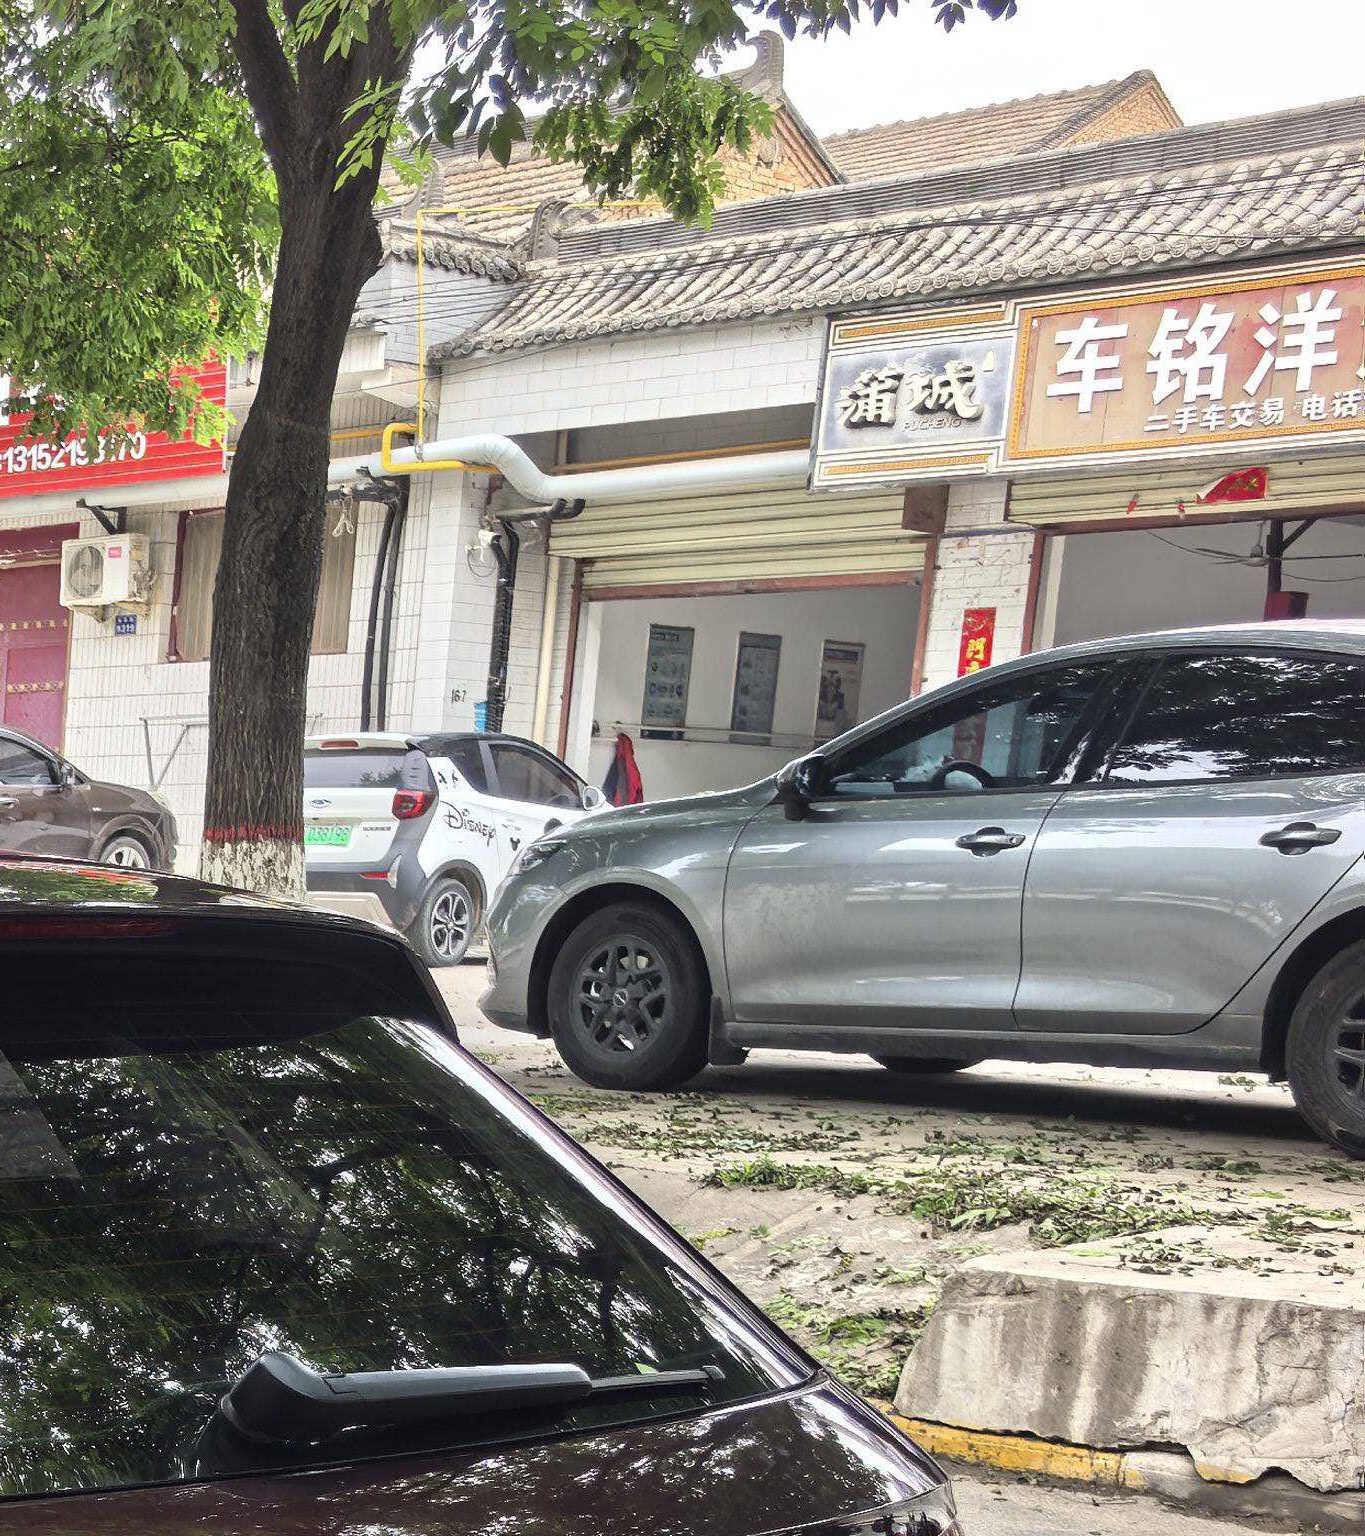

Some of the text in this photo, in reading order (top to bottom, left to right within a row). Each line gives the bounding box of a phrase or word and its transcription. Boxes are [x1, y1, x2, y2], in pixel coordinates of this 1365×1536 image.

[1046, 288, 1365, 413] 车铭洋
[835, 360, 984, 428] 蒲城
[1143, 396, 1285, 434] 二手车交易
[902, 417, 963, 432] PUCHENG
